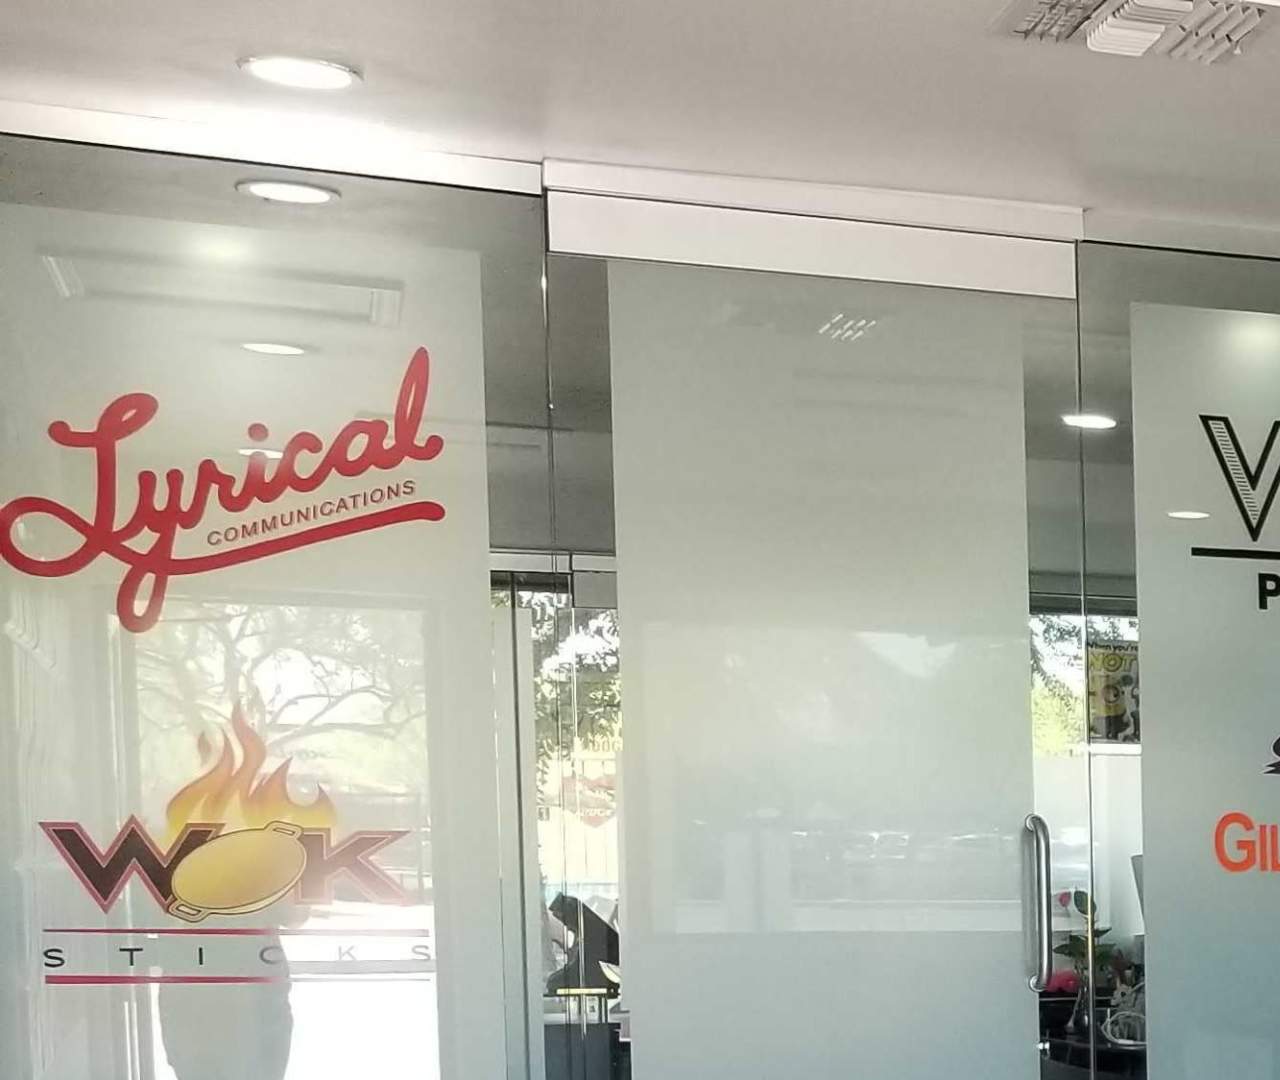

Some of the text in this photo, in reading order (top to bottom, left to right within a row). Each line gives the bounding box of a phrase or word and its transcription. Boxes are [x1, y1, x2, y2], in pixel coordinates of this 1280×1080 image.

[0, 347, 444, 632] Lyrical
[206, 480, 416, 546] COMMUNICATIONS
[38, 813, 424, 922] WOK
[42, 944, 433, 969] STICKS
